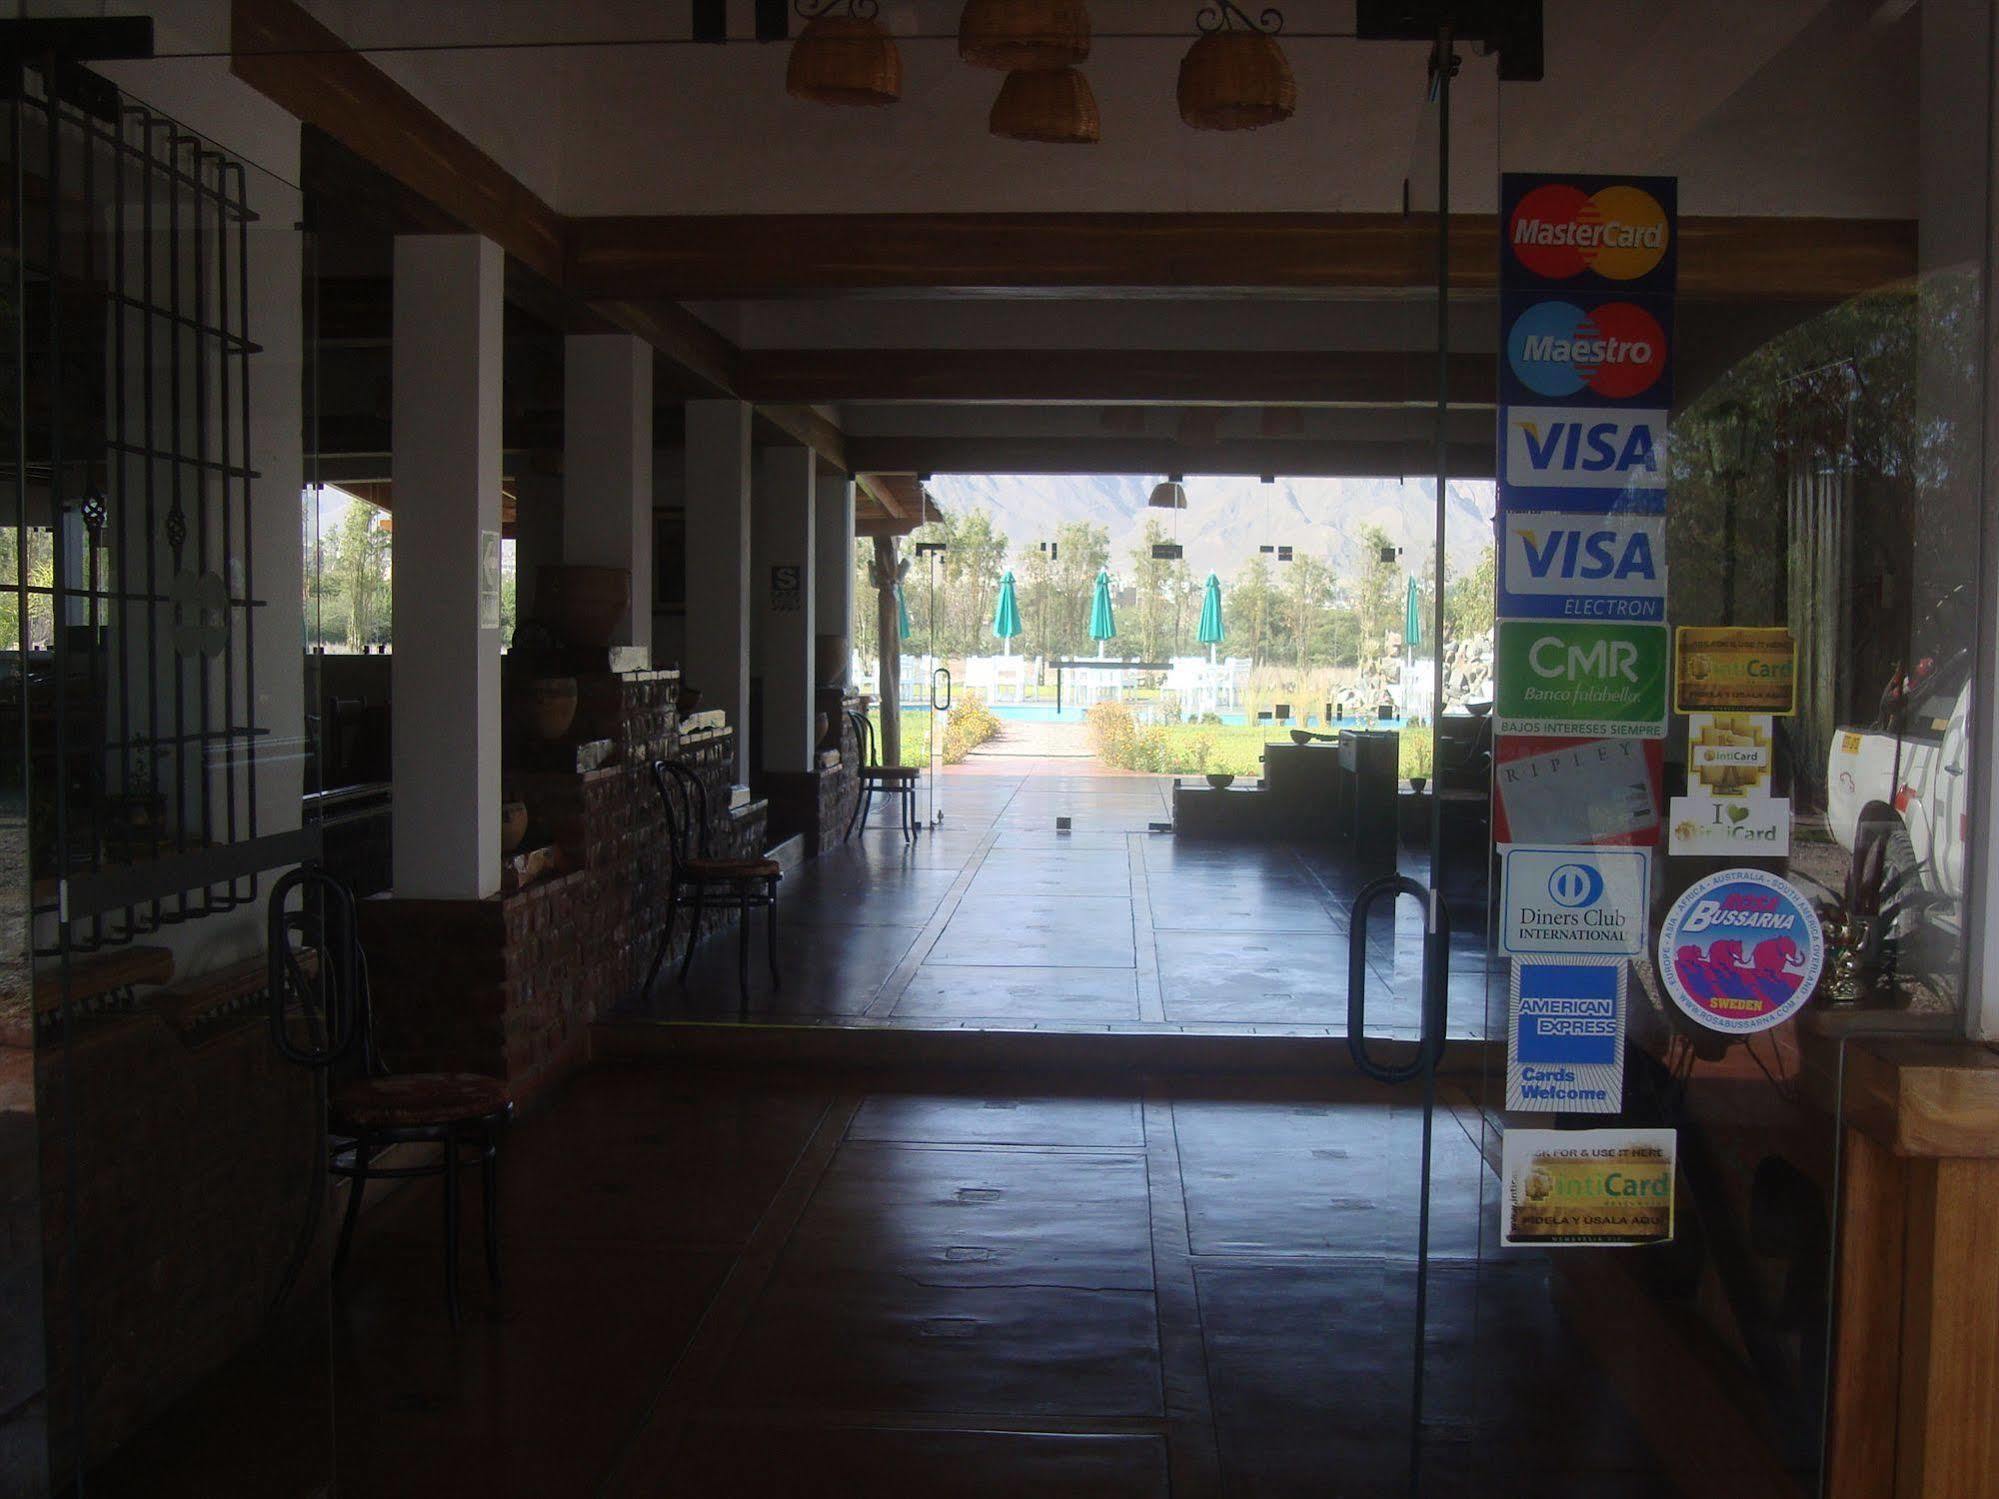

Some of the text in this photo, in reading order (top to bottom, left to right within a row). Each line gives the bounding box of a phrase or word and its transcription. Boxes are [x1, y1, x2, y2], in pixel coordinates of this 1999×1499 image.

[1514, 219, 1662, 249] MasterCard
[1522, 335, 1652, 364] Maestro
[1513, 422, 1657, 472] VISA
[1512, 529, 1656, 580] VISA
[1564, 599, 1656, 616] ELECTRON
[1528, 636, 1639, 683] CMR
[1524, 686, 1571, 701] Banco
[1501, 722, 1661, 736] BAJOS INTERESES SIEMPRE
[1712, 803, 1724, 825] I
[1712, 872, 1765, 886] AUSTRALIA
[1678, 884, 1706, 913] AFRICA
[1772, 879, 1800, 901] SOUTH
[1520, 908, 1627, 927] Diners Club
[1519, 928, 1626, 941] INTERNATIONAL
[1665, 917, 1678, 938] ASIA
[1663, 946, 1676, 987] EUROPE
[1519, 1000, 1611, 1015] AMERICAN
[1708, 997, 1764, 1011] SWEDEN
[1539, 1020, 1617, 1034] EXPRESS
[1521, 1067, 1576, 1082] Cards
[1521, 1084, 1607, 1100] Welcome
[1592, 1149, 1615, 1157] USE
[1630, 1149, 1663, 1157] HERE
[1554, 1172, 1670, 1197] intiCard
[1571, 1216, 1581, 1225] Y
